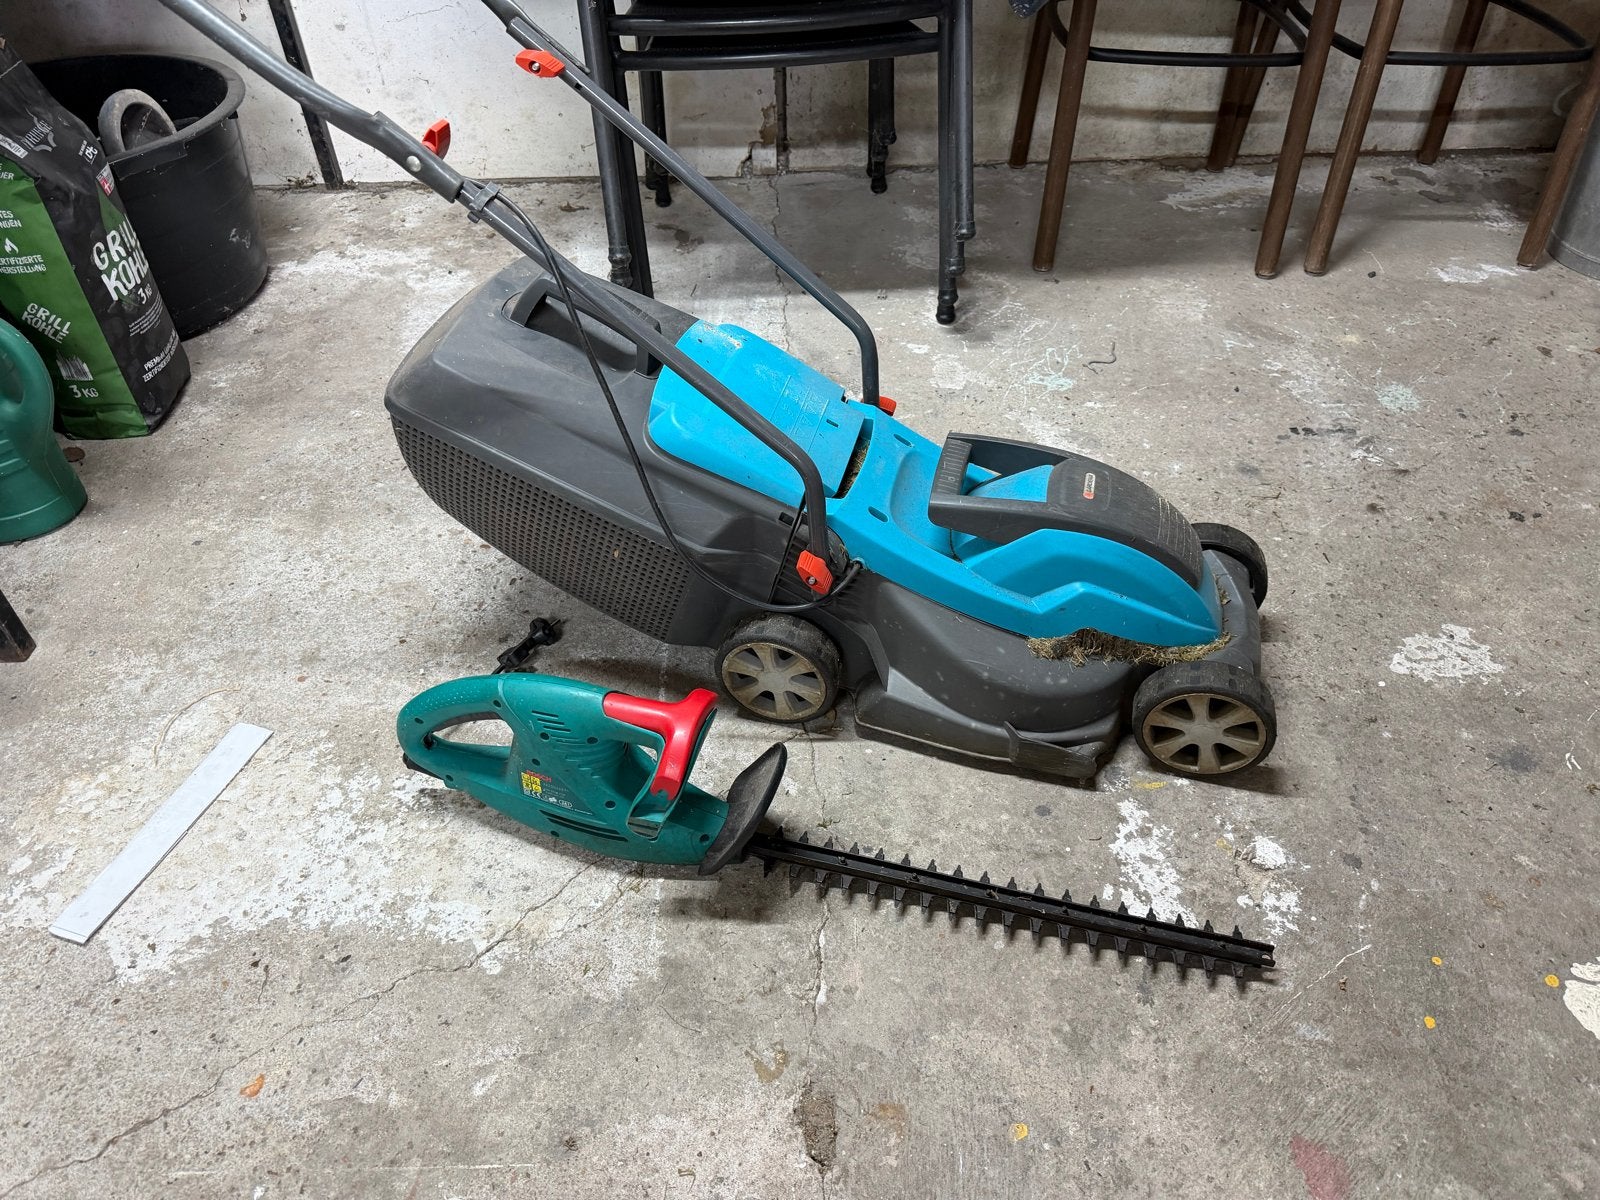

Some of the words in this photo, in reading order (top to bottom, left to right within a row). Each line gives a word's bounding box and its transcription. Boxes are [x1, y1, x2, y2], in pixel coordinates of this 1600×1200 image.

[137, 287, 147, 304] 3
[22, 311, 67, 344] KOHLE
[27, 303, 71, 334] GRILL
[69, 385, 81, 398] 3
[82, 388, 99, 398] KG
